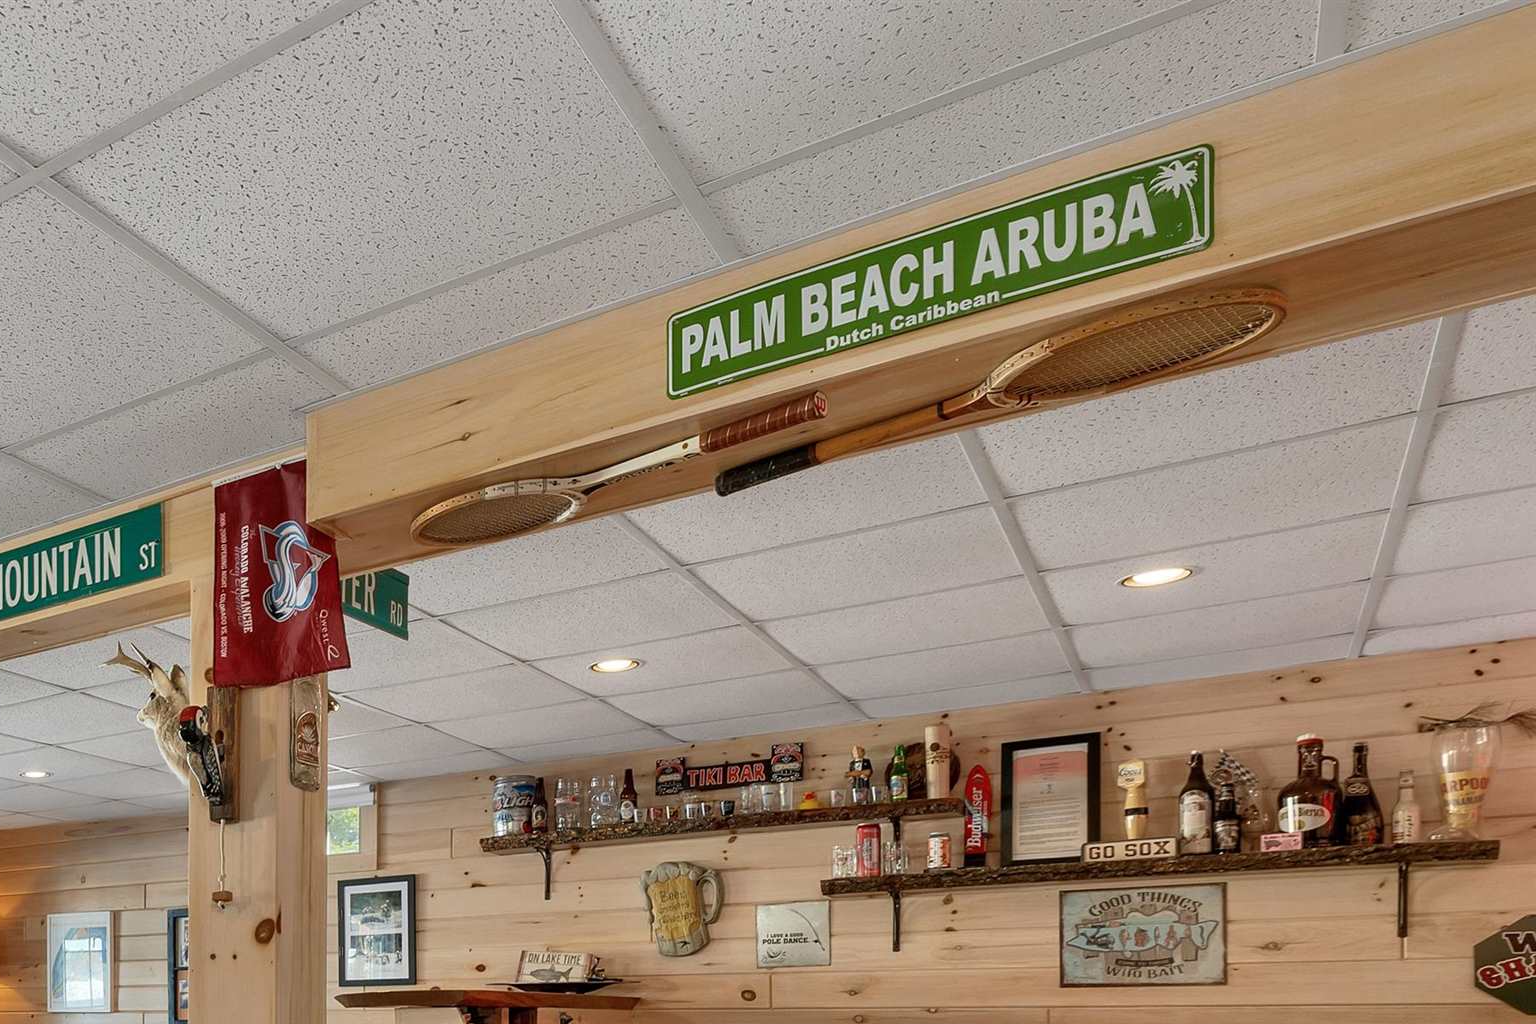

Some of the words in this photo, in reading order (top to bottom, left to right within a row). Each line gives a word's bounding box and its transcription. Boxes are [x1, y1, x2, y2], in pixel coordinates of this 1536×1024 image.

[681, 296, 786, 374] PALM
[801, 239, 955, 337] BEACH
[970, 182, 1157, 285] ARUBA
[825, 317, 884, 352] Dutch
[890, 290, 1000, 331] Caribbean
[139, 540, 159, 571] ST
[241, 525, 249, 574] COLORADO
[219, 593, 227, 625] COLORADO
[240, 576, 253, 634] AVALANCHE
[390, 600, 403, 626] RD
[319, 609, 329, 644] Qwest
[687, 767, 723, 787] TIKI
[727, 762, 766, 784] BAR
[504, 796, 535, 808] LIGH
[966, 787, 984, 847] Budweiser
[1089, 845, 1115, 860] GO
[1125, 840, 1171, 857] SOX
[1088, 893, 1132, 916] GOOD
[1137, 891, 1203, 913] THINGS
[527, 953, 540, 964] ON
[541, 953, 561, 965] LAKE
[562, 955, 582, 965] TIME
[1147, 963, 1186, 979] BAIT
